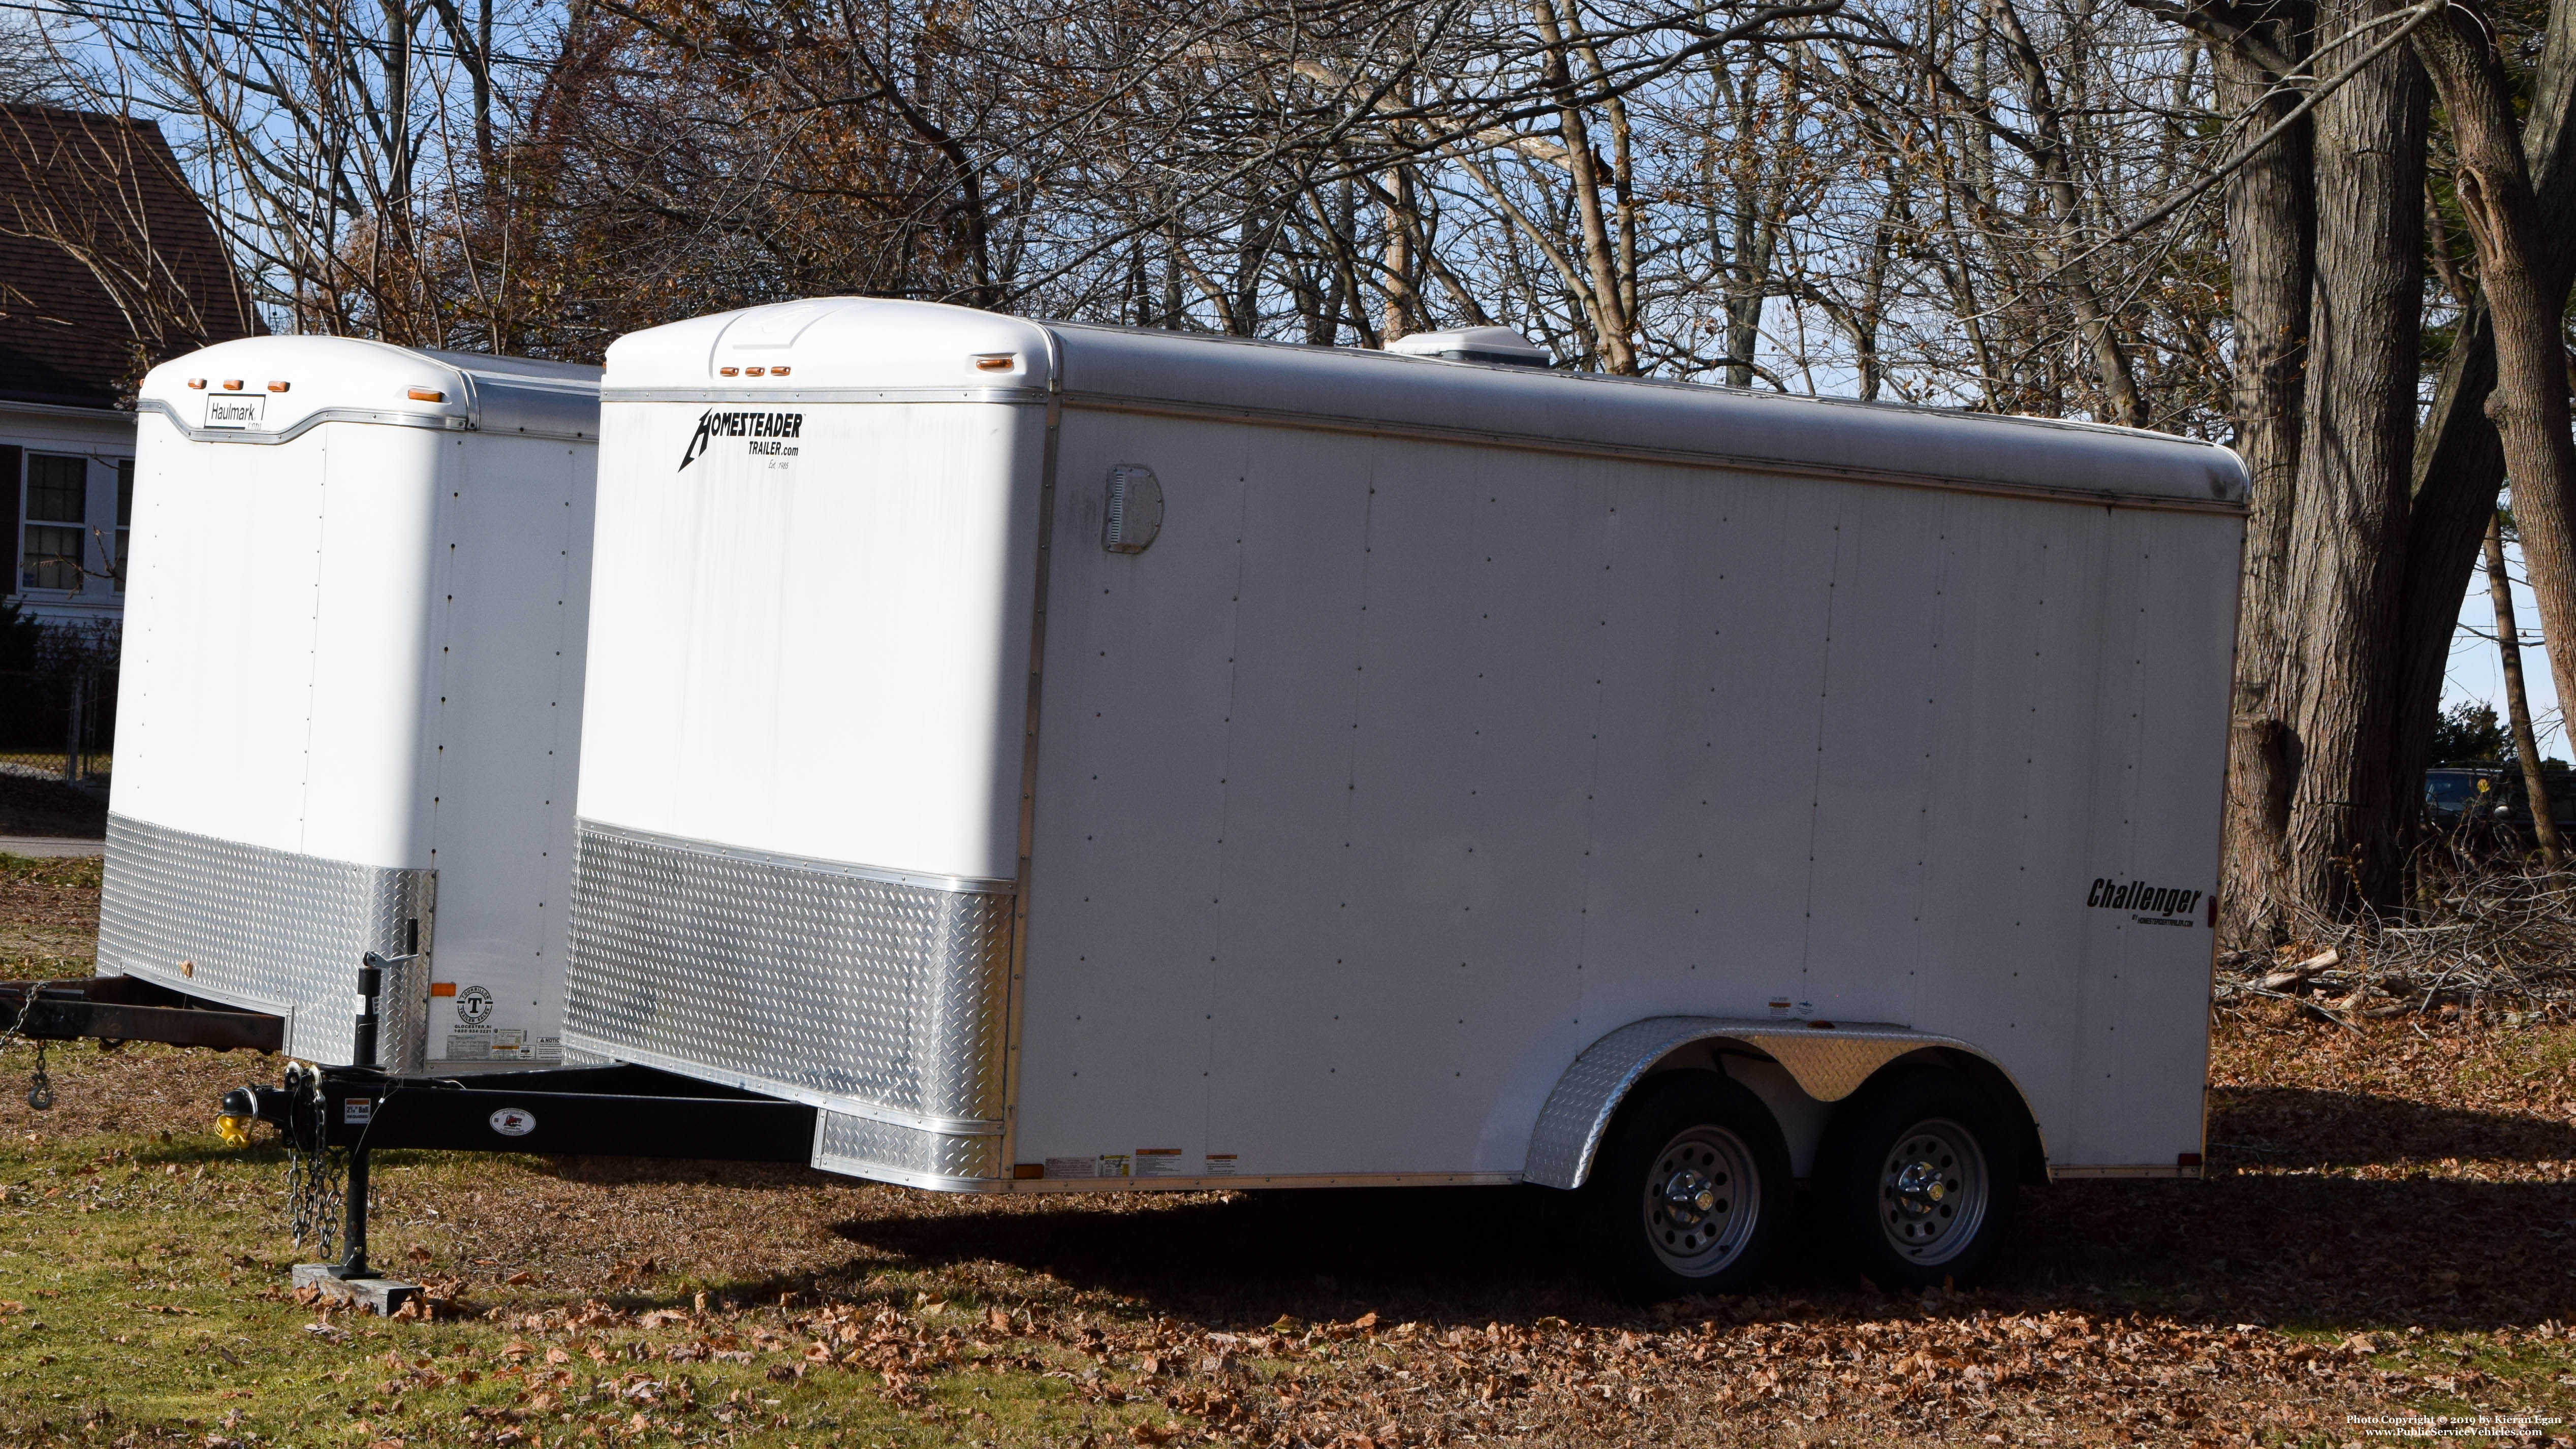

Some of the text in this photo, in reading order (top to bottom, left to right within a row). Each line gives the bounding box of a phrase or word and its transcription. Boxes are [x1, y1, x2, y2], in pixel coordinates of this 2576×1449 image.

[211, 402, 255, 421] Haulmark
[678, 407, 803, 473] HOMESTEADER
[2087, 878, 2202, 917] Challenger
[461, 987, 490, 1000] TOURBILLON
[467, 997, 482, 1014] T
[459, 1007, 490, 1023] TRAILER SALES
